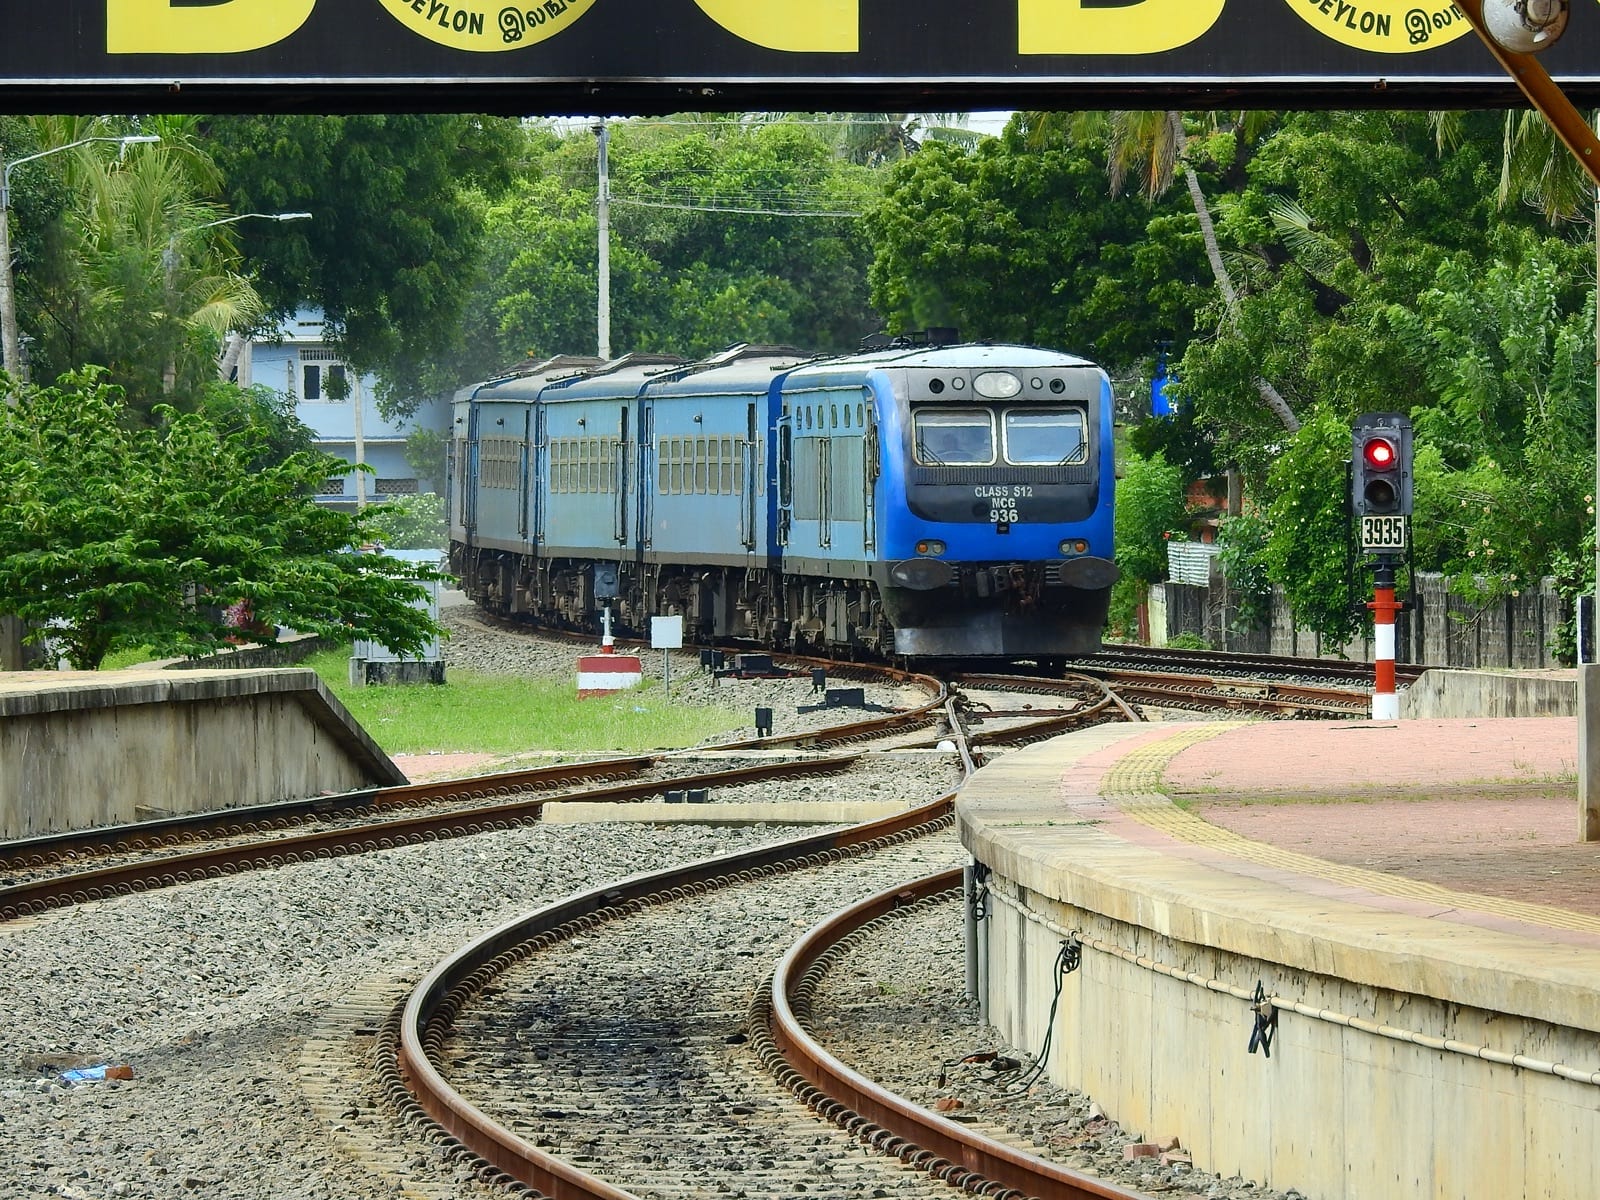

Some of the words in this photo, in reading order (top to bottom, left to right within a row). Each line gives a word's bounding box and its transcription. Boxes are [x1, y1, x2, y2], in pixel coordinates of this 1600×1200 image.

[402, 0, 484, 35] EYLON
[1309, 0, 1391, 37] EYLON
[974, 486, 1009, 498] CLASS
[1013, 486, 1033, 498] S12
[991, 497, 1016, 509] MCG
[990, 509, 1019, 523] 936
[1364, 518, 1402, 545] 3935
